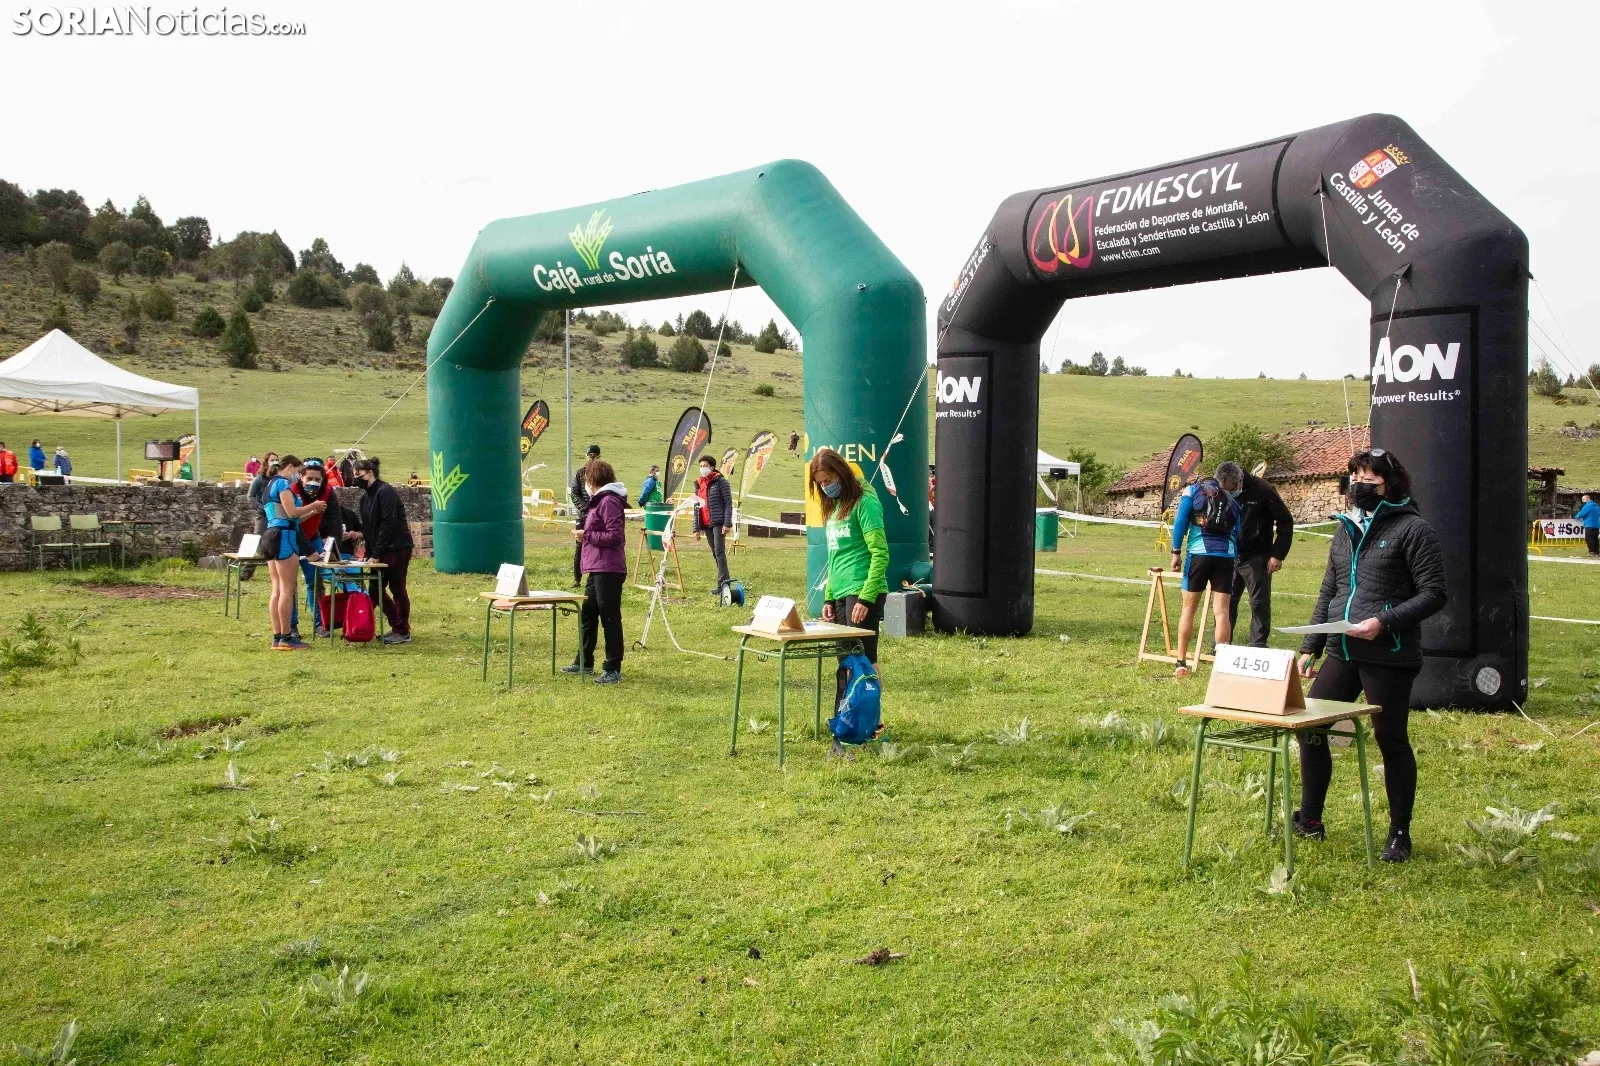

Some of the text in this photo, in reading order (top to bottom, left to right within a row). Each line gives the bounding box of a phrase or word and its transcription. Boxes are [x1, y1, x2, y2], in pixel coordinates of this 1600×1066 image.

[1095, 162, 1242, 217] FDMESCYL
[1094, 200, 1248, 236] Federación de Deportes de Montaña,
[1096, 210, 1270, 250] Escalada y Senderismo de Castilla y León
[1330, 172, 1406, 254] Castilla y León
[1367, 189, 1420, 241] Junta de
[533, 245, 677, 294] Caja rural de Soria
[1100, 245, 1161, 262] www.fclm.com
[1372, 337, 1461, 385] AON
[936, 370, 982, 403] AON
[1232, 656, 1270, 673] 41-50
